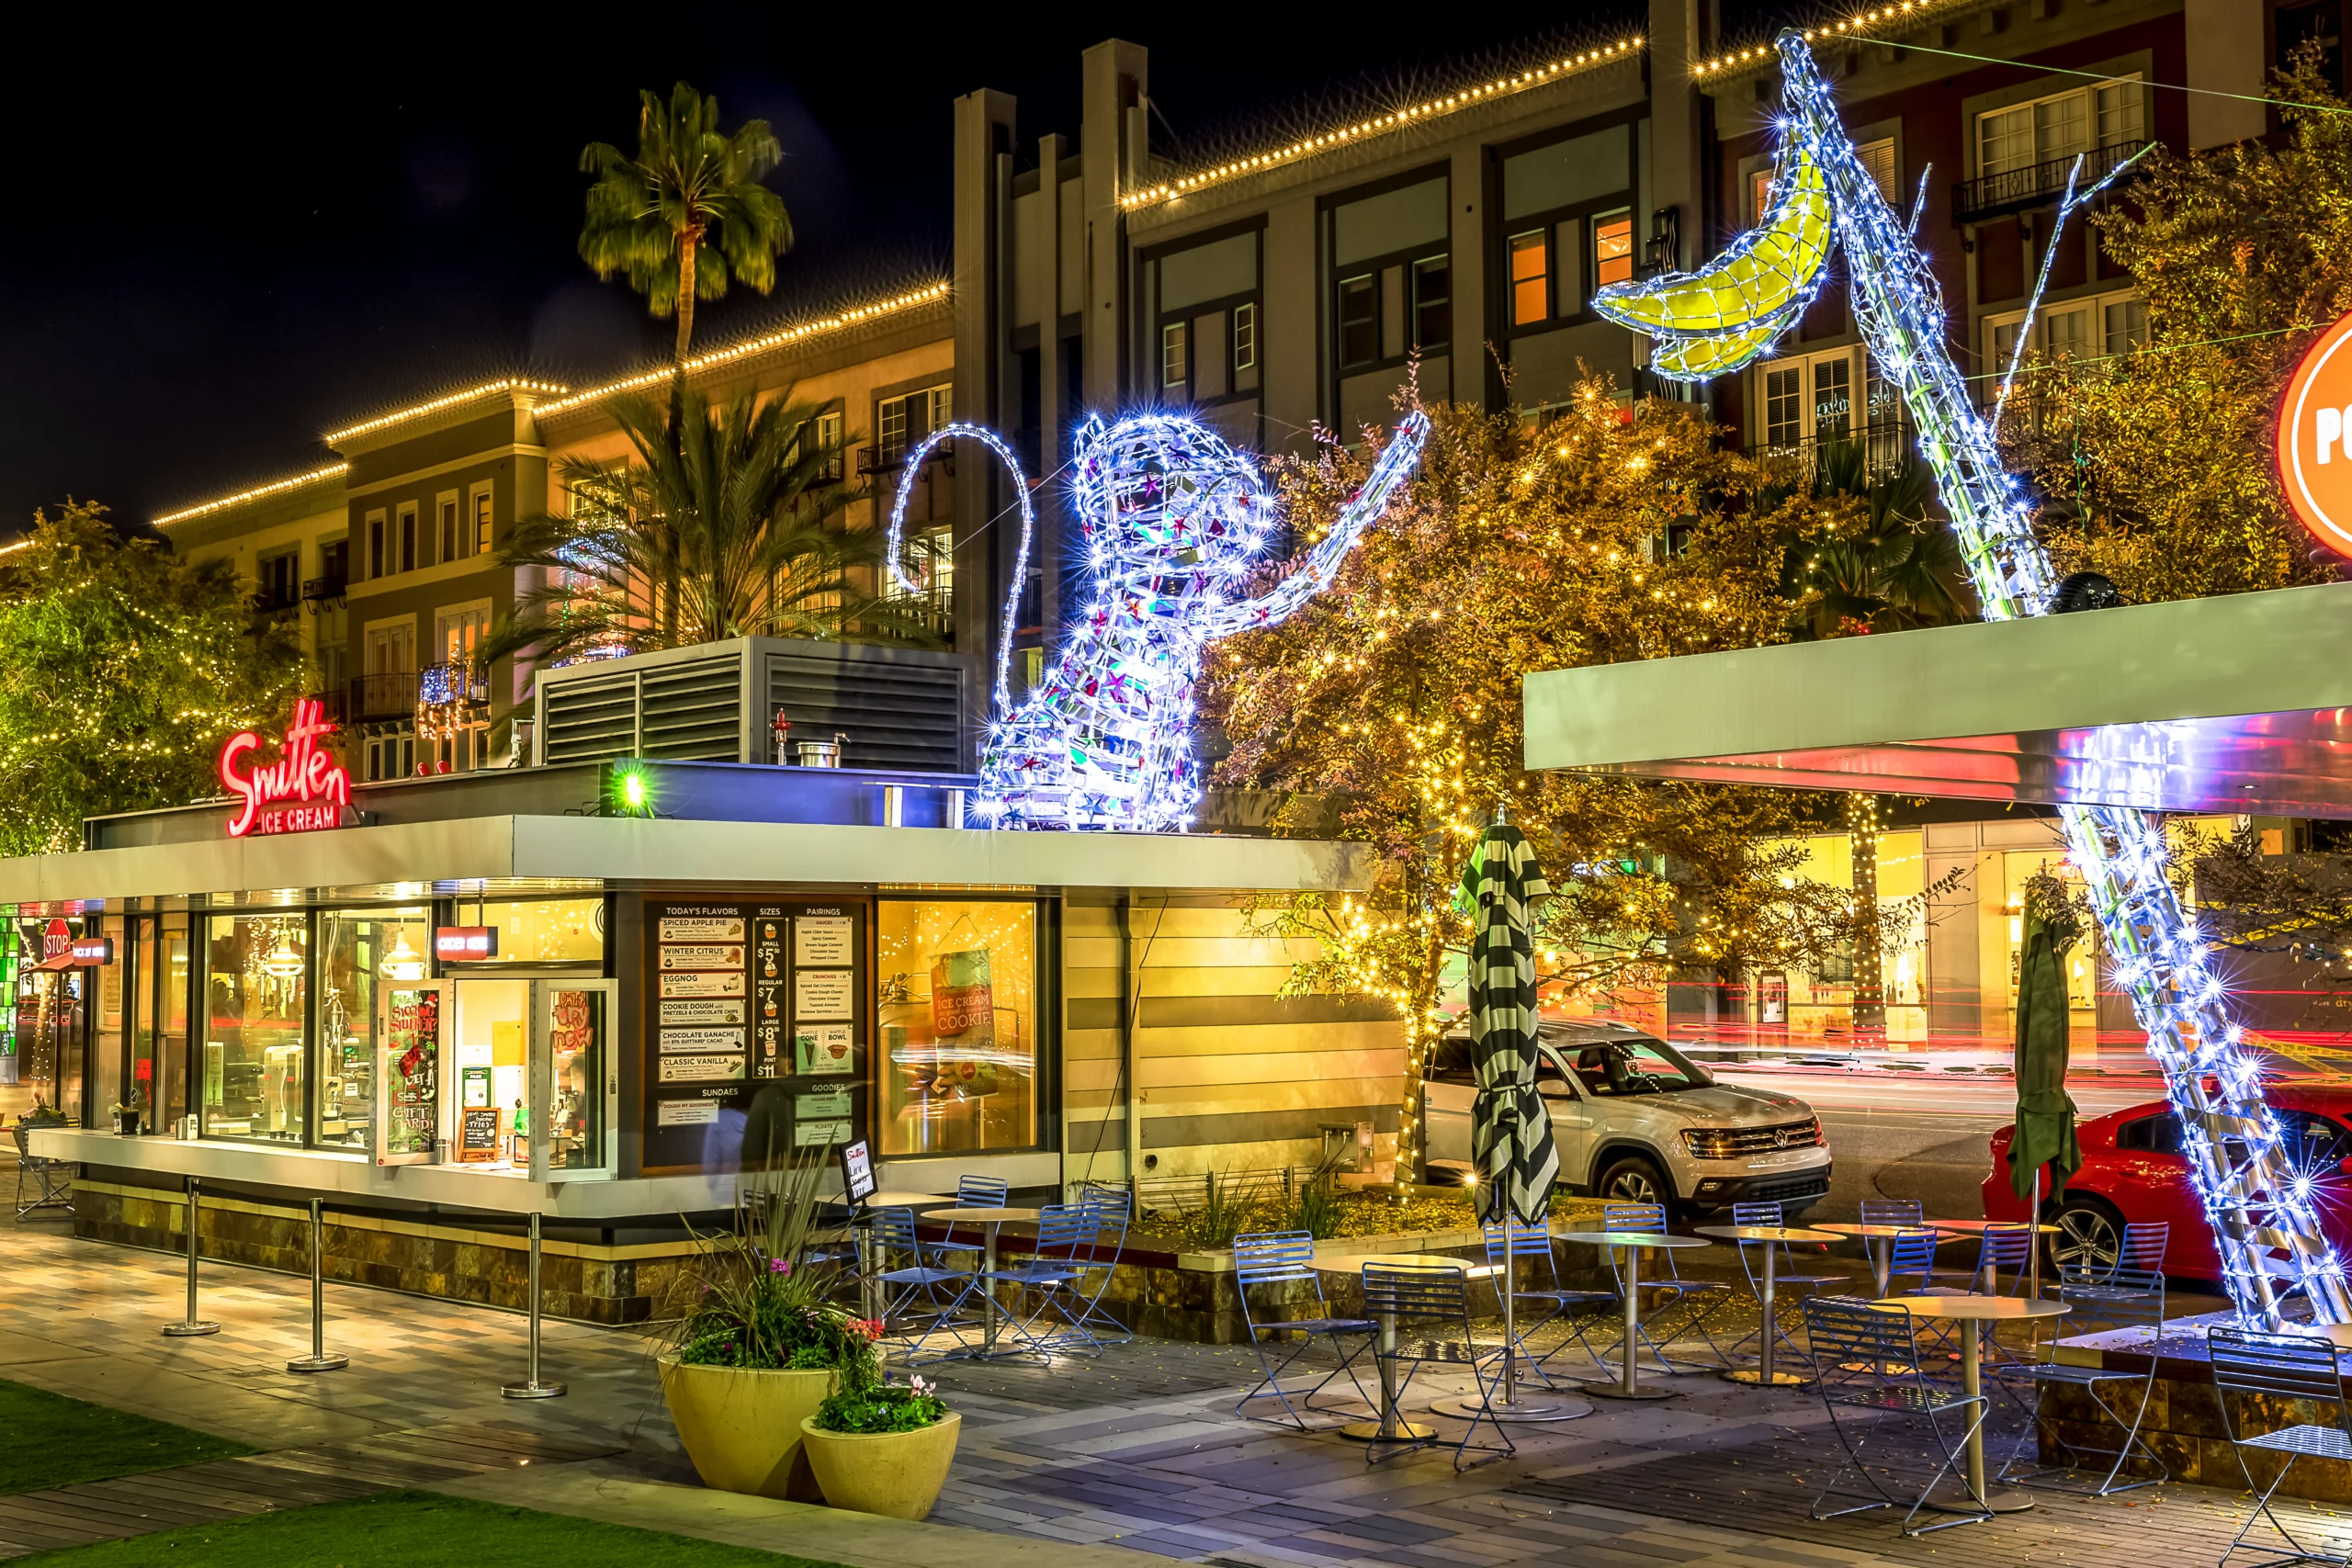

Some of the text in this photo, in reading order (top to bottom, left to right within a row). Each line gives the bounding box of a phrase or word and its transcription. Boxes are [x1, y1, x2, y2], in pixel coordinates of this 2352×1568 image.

[221, 698, 347, 837] Smitten
[261, 806, 334, 833] ICE CREAM
[666, 907, 700, 915] TODAY'S
[759, 908, 781, 916] SIZES
[46, 934, 68, 953] STOP
[937, 998, 955, 1010] ICE
[956, 995, 989, 1007] CREAM
[937, 1011, 990, 1030] COOKIE
[757, 1065, 775, 1078] $11
[702, 1088, 739, 1097] SUNDAES
[811, 1084, 845, 1092] GOODIES
